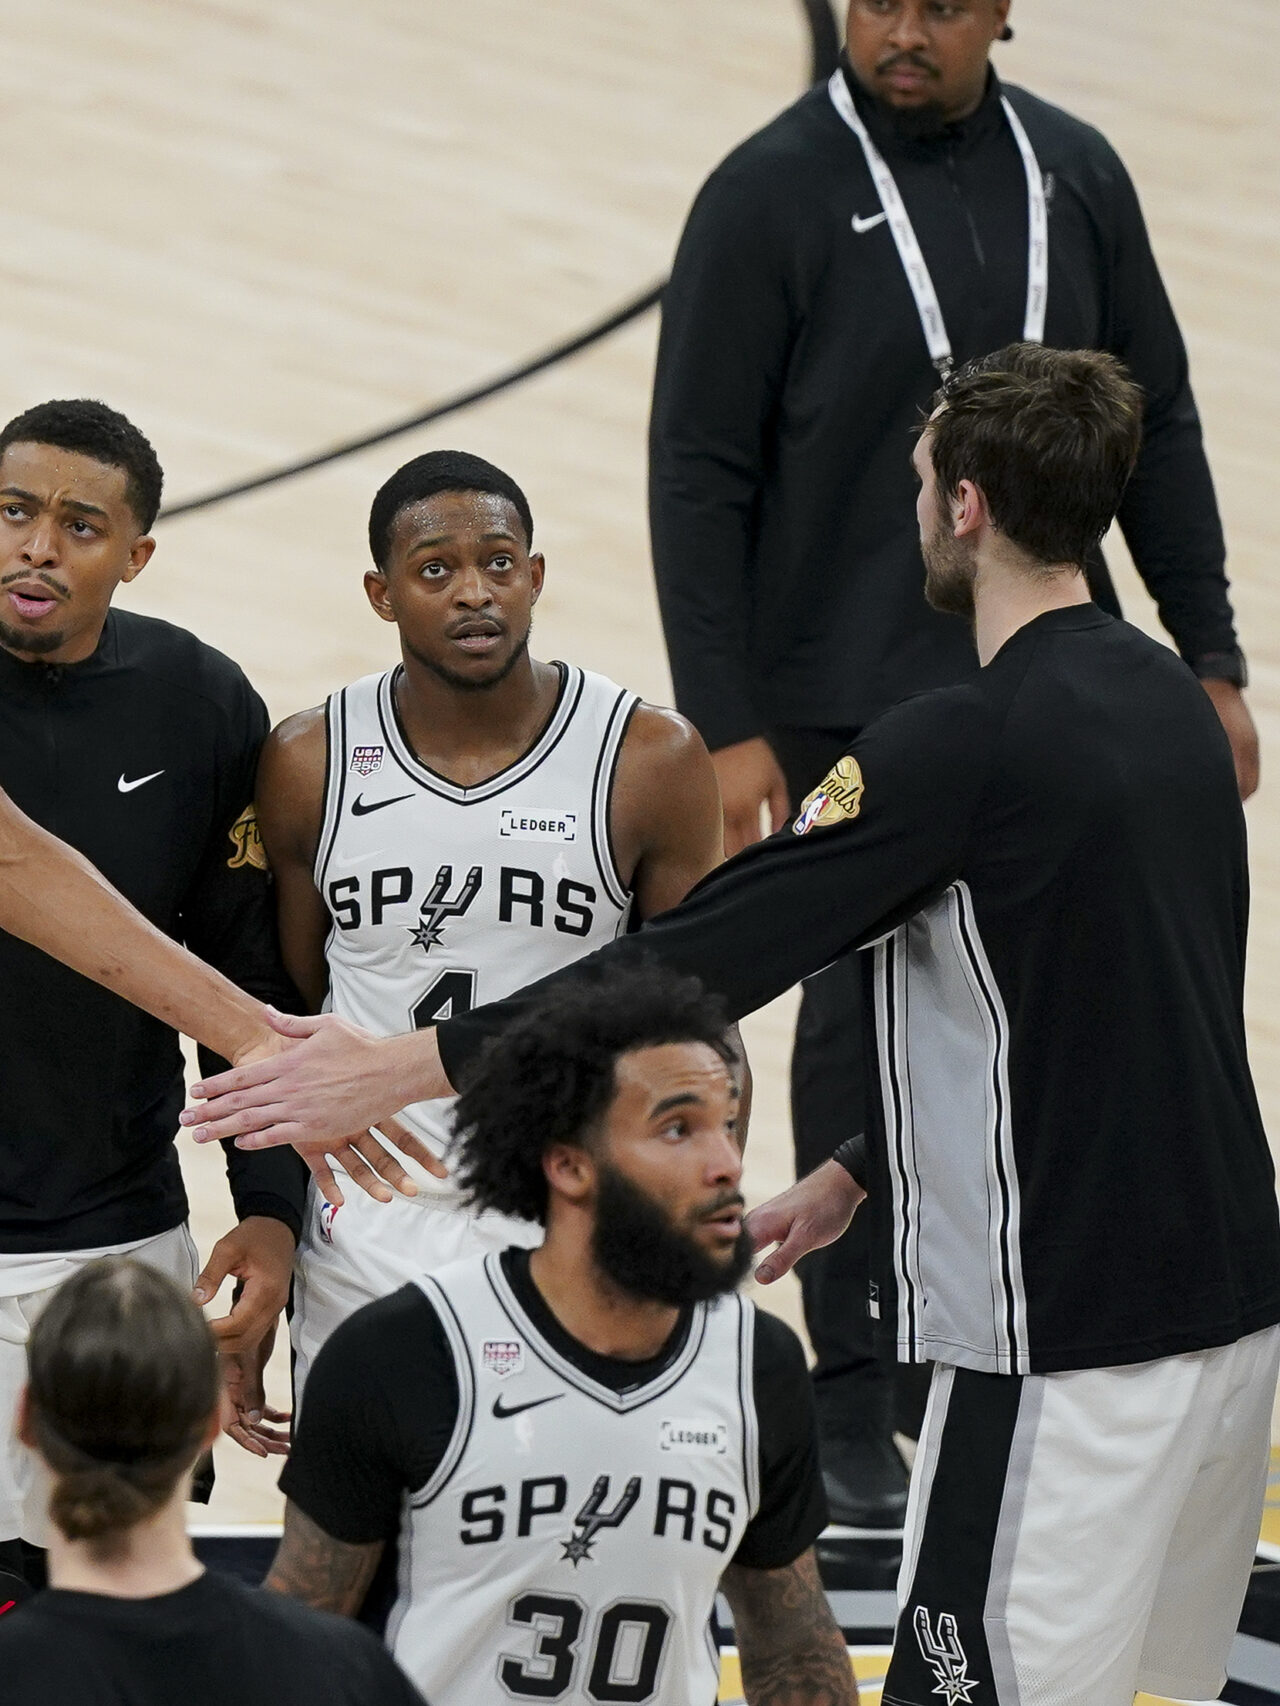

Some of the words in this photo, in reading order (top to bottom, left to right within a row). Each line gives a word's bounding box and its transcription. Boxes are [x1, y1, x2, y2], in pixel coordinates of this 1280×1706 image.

[351, 761, 382, 771] 250
[354, 748, 383, 758] USA
[509, 817, 567, 834] LEDGER
[328, 865, 597, 953] SPURS
[409, 969, 478, 1031] 4
[669, 1429, 718, 1445] LEDGER
[460, 1475, 736, 1569] SPURS
[496, 1588, 676, 1704] 30
